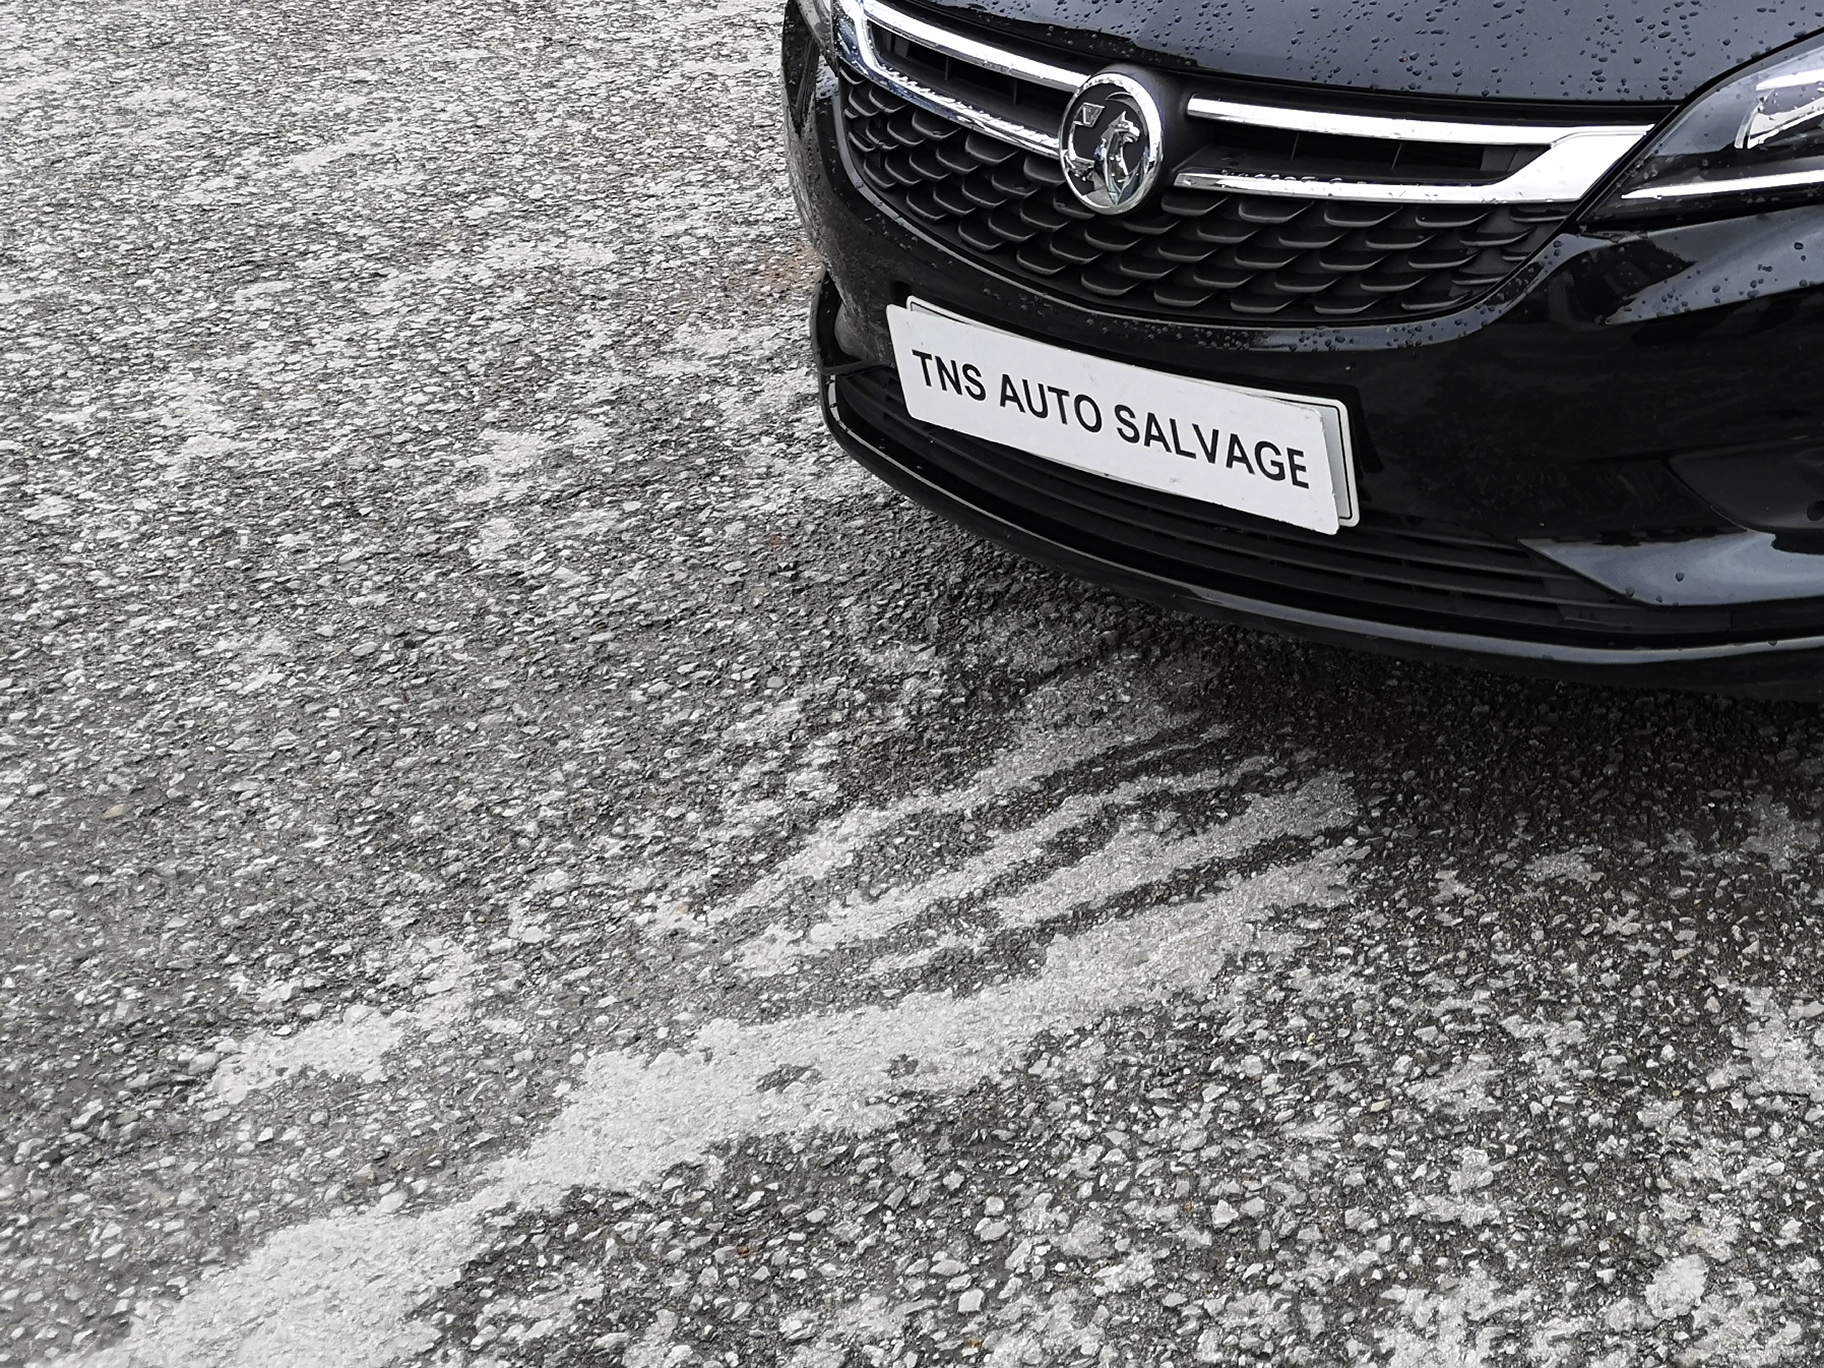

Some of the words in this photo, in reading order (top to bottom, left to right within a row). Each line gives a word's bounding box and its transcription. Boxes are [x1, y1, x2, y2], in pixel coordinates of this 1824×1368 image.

[912, 349, 987, 402] TNS
[999, 373, 1102, 433] AUTO
[1115, 403, 1311, 490] SALVAGE
